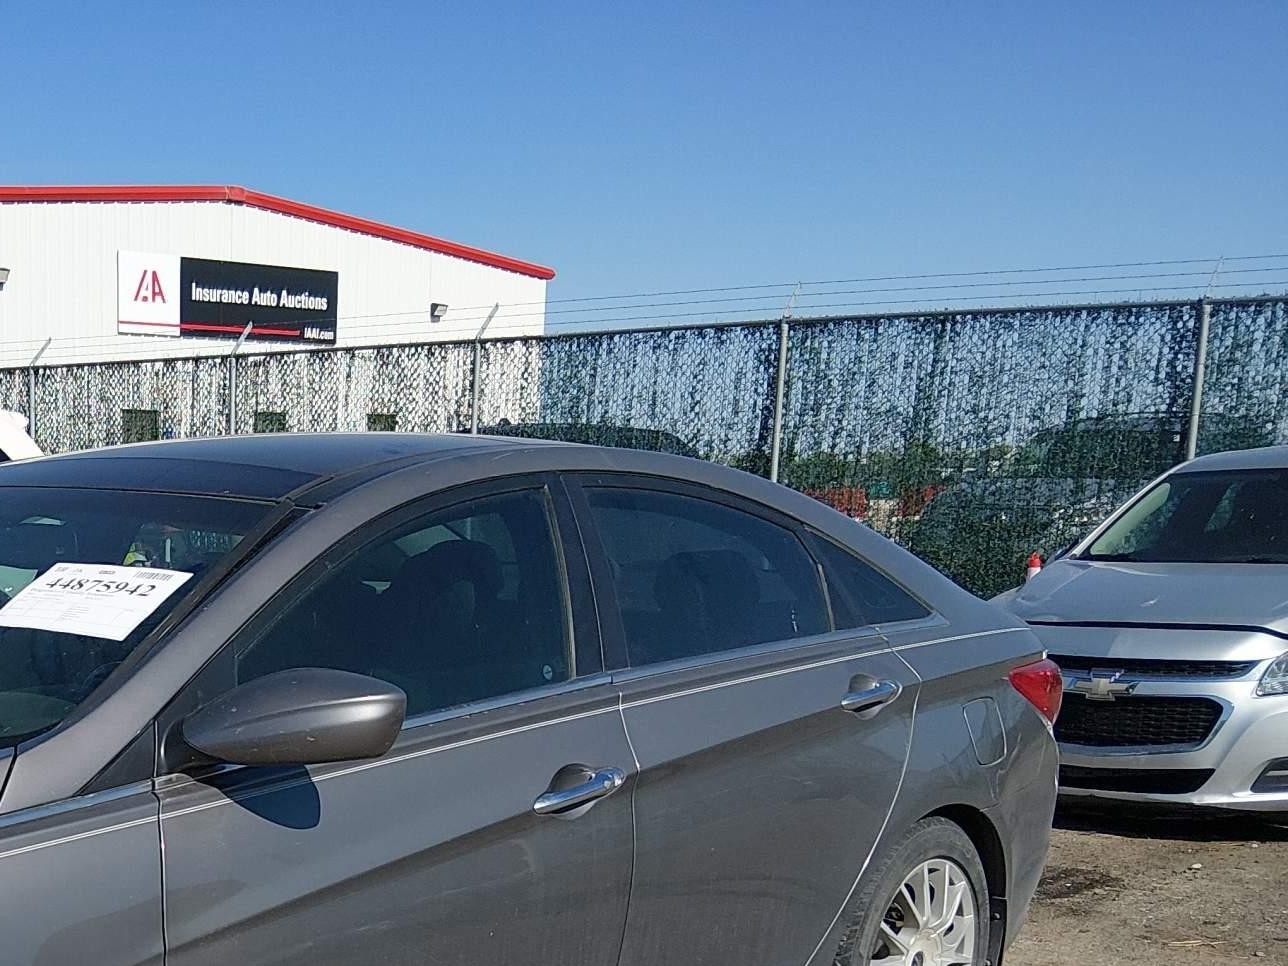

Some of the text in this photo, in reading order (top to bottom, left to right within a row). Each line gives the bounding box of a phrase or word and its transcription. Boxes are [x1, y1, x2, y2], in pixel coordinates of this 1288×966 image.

[191, 281, 328, 311] Insurance Auto Auctions
[46, 577, 156, 597] 44875942
